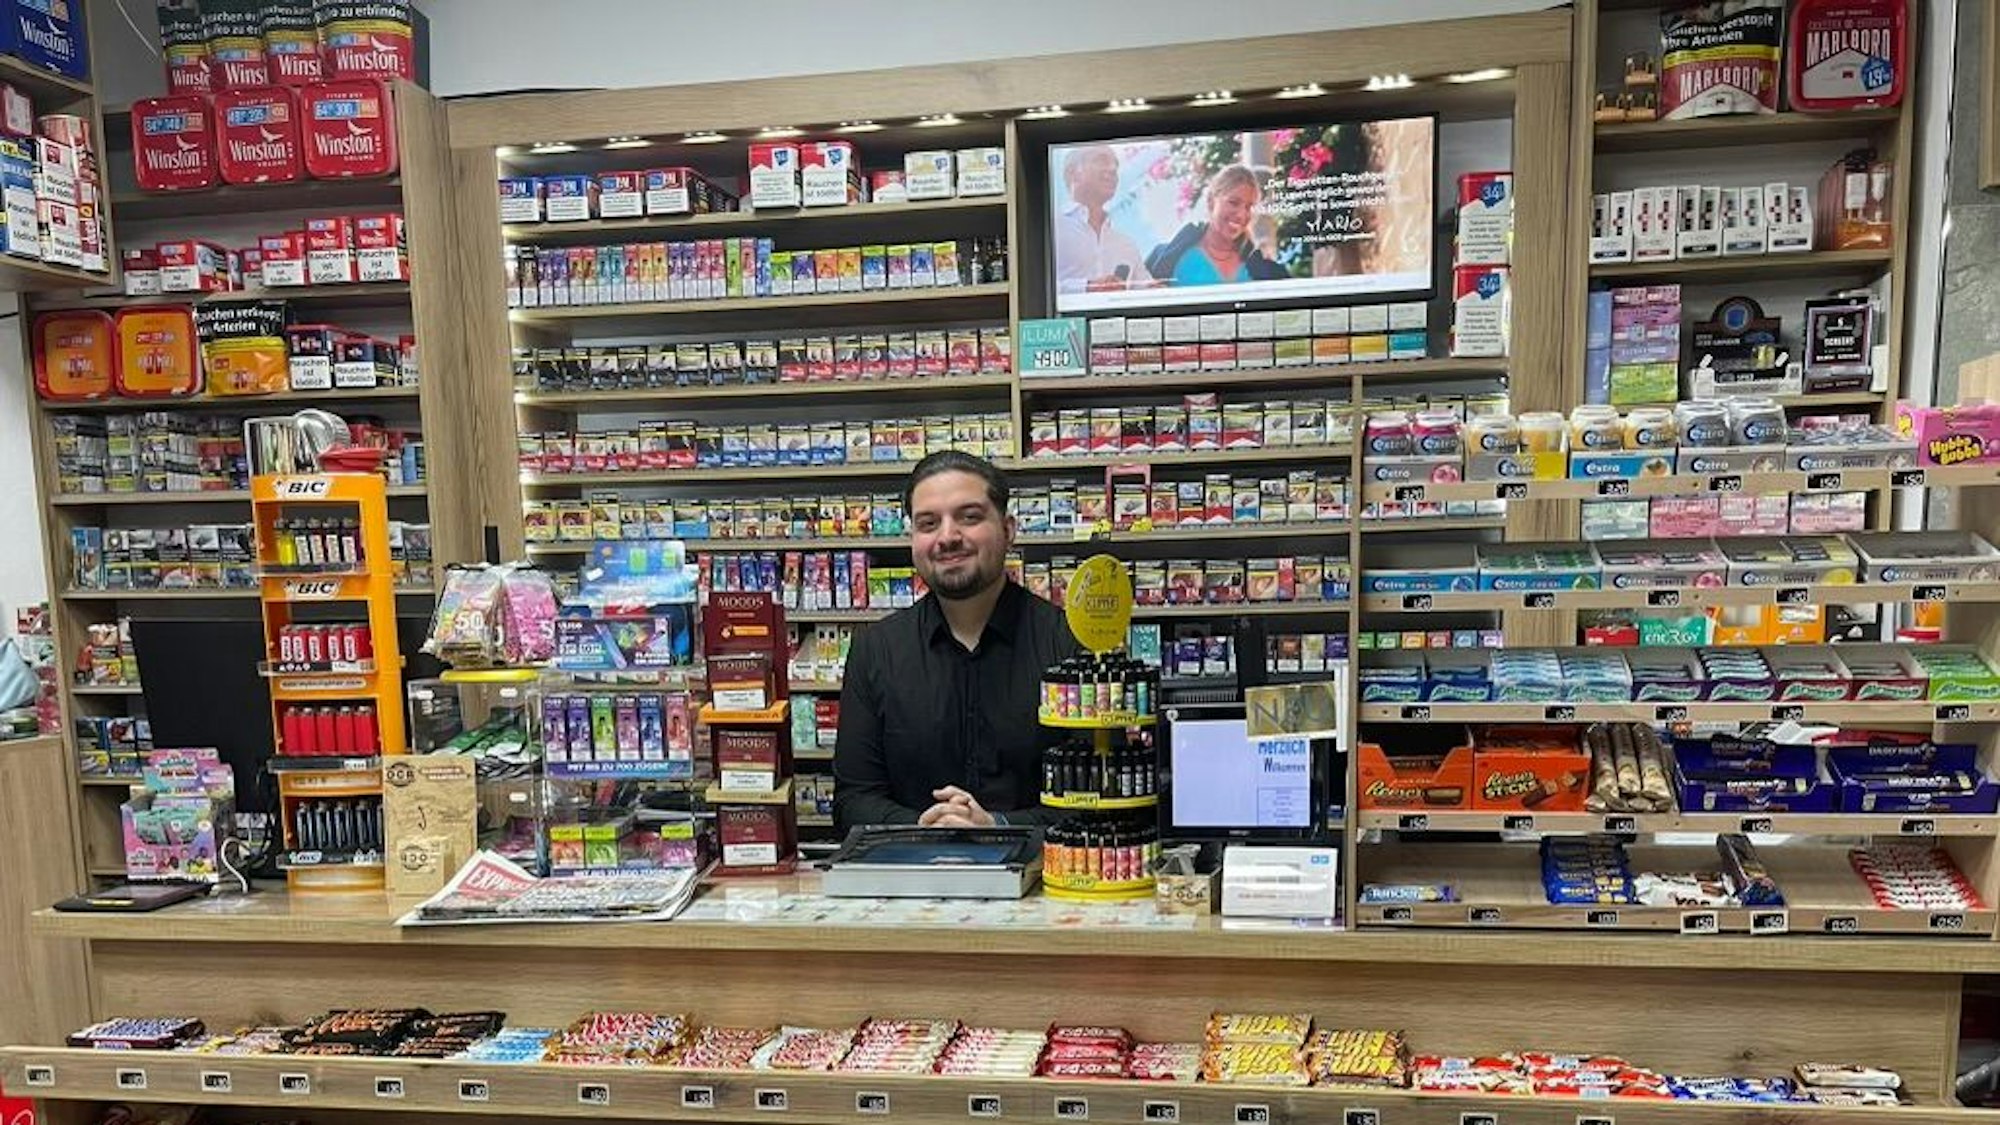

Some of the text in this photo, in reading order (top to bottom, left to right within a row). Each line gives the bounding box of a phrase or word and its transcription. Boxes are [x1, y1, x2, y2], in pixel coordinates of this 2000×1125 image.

[19, 16, 70, 55] Winston
[1806, 29, 1891, 68] MARLBORO
[337, 48, 398, 71] Winston
[1680, 66, 1760, 103] MARLBORO
[229, 139, 285, 162] Winston
[315, 132, 372, 156] Winston
[146, 149, 200, 170] Winston
[1929, 437, 1973, 456] Hubba
[1376, 465, 1411, 481] extra
[1586, 460, 1621, 476] extra
[1692, 457, 1729, 473] extra
[1798, 456, 1836, 473] extra
[288, 482, 325, 493] BIC
[1881, 564, 1919, 582] extra
[298, 583, 334, 594] BIC
[1493, 576, 1526, 590] extra
[718, 596, 764, 608] MOODS
[455, 612, 485, 630] 50
[726, 737, 770, 748] MOODS
